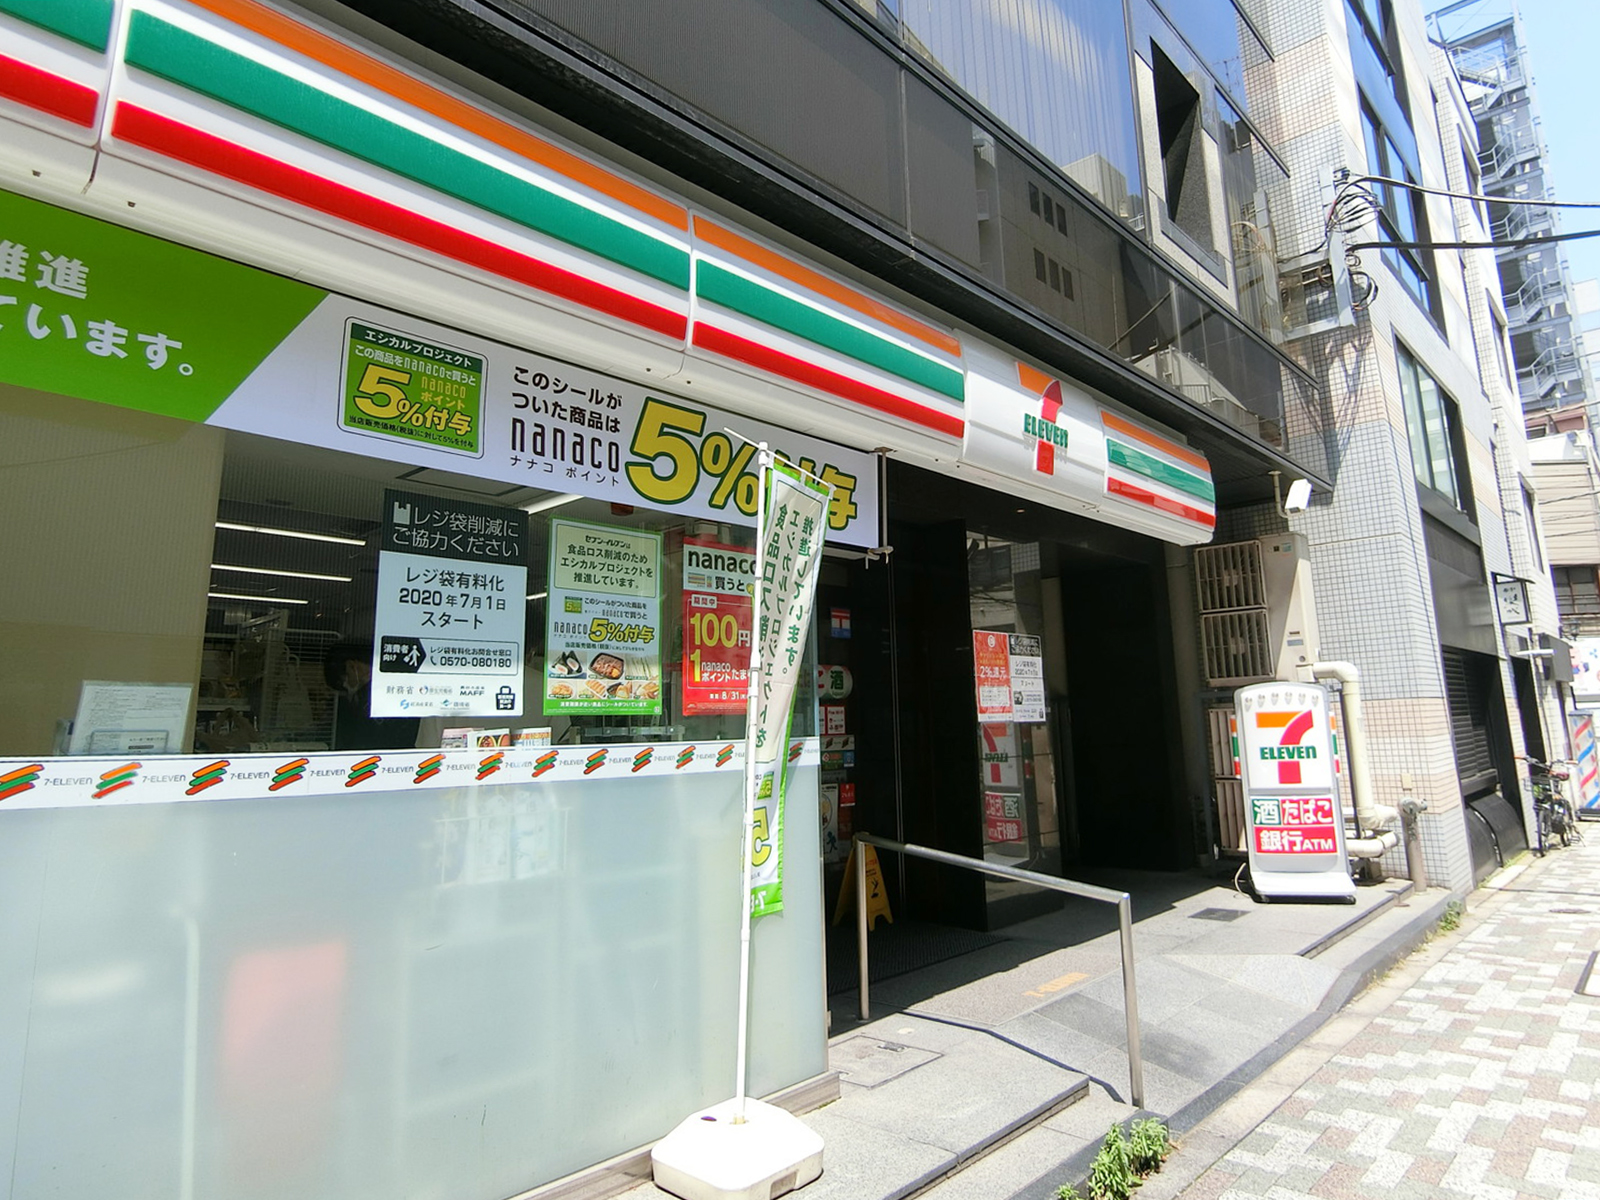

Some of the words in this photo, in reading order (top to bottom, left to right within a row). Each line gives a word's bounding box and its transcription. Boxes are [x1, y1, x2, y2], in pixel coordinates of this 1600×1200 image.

[364, 329, 472, 368] エシカルプロジェクト
[353, 362, 473, 436] 5%付与
[420, 390, 466, 411] ポイント
[421, 376, 467, 399] nanaco
[513, 366, 623, 410] このシールが
[511, 391, 621, 434] ついた商品は
[511, 416, 620, 474] nanaco
[510, 454, 554, 474] ナナコ
[566, 466, 620, 487] ポイント
[414, 506, 519, 538] レジ袋削減に
[392, 526, 519, 557] ご協力ください
[567, 543, 649, 565] 食品ロス削減のため
[406, 566, 505, 592] レジ袋有料化
[560, 557, 654, 579] エシカルプロジェクトを
[573, 572, 640, 589] 推進しています。
[715, 575, 745, 592] 買うと
[421, 611, 484, 630] スタート
[554, 621, 588, 635] nanaco
[588, 617, 656, 644] 5%付与
[440, 656, 512, 668] 0570-080180
[701, 662, 731, 672] nanaco
[701, 672, 731, 682] ポイント
[1254, 799, 1281, 825] 酒
[1281, 798, 1334, 825] たばこ
